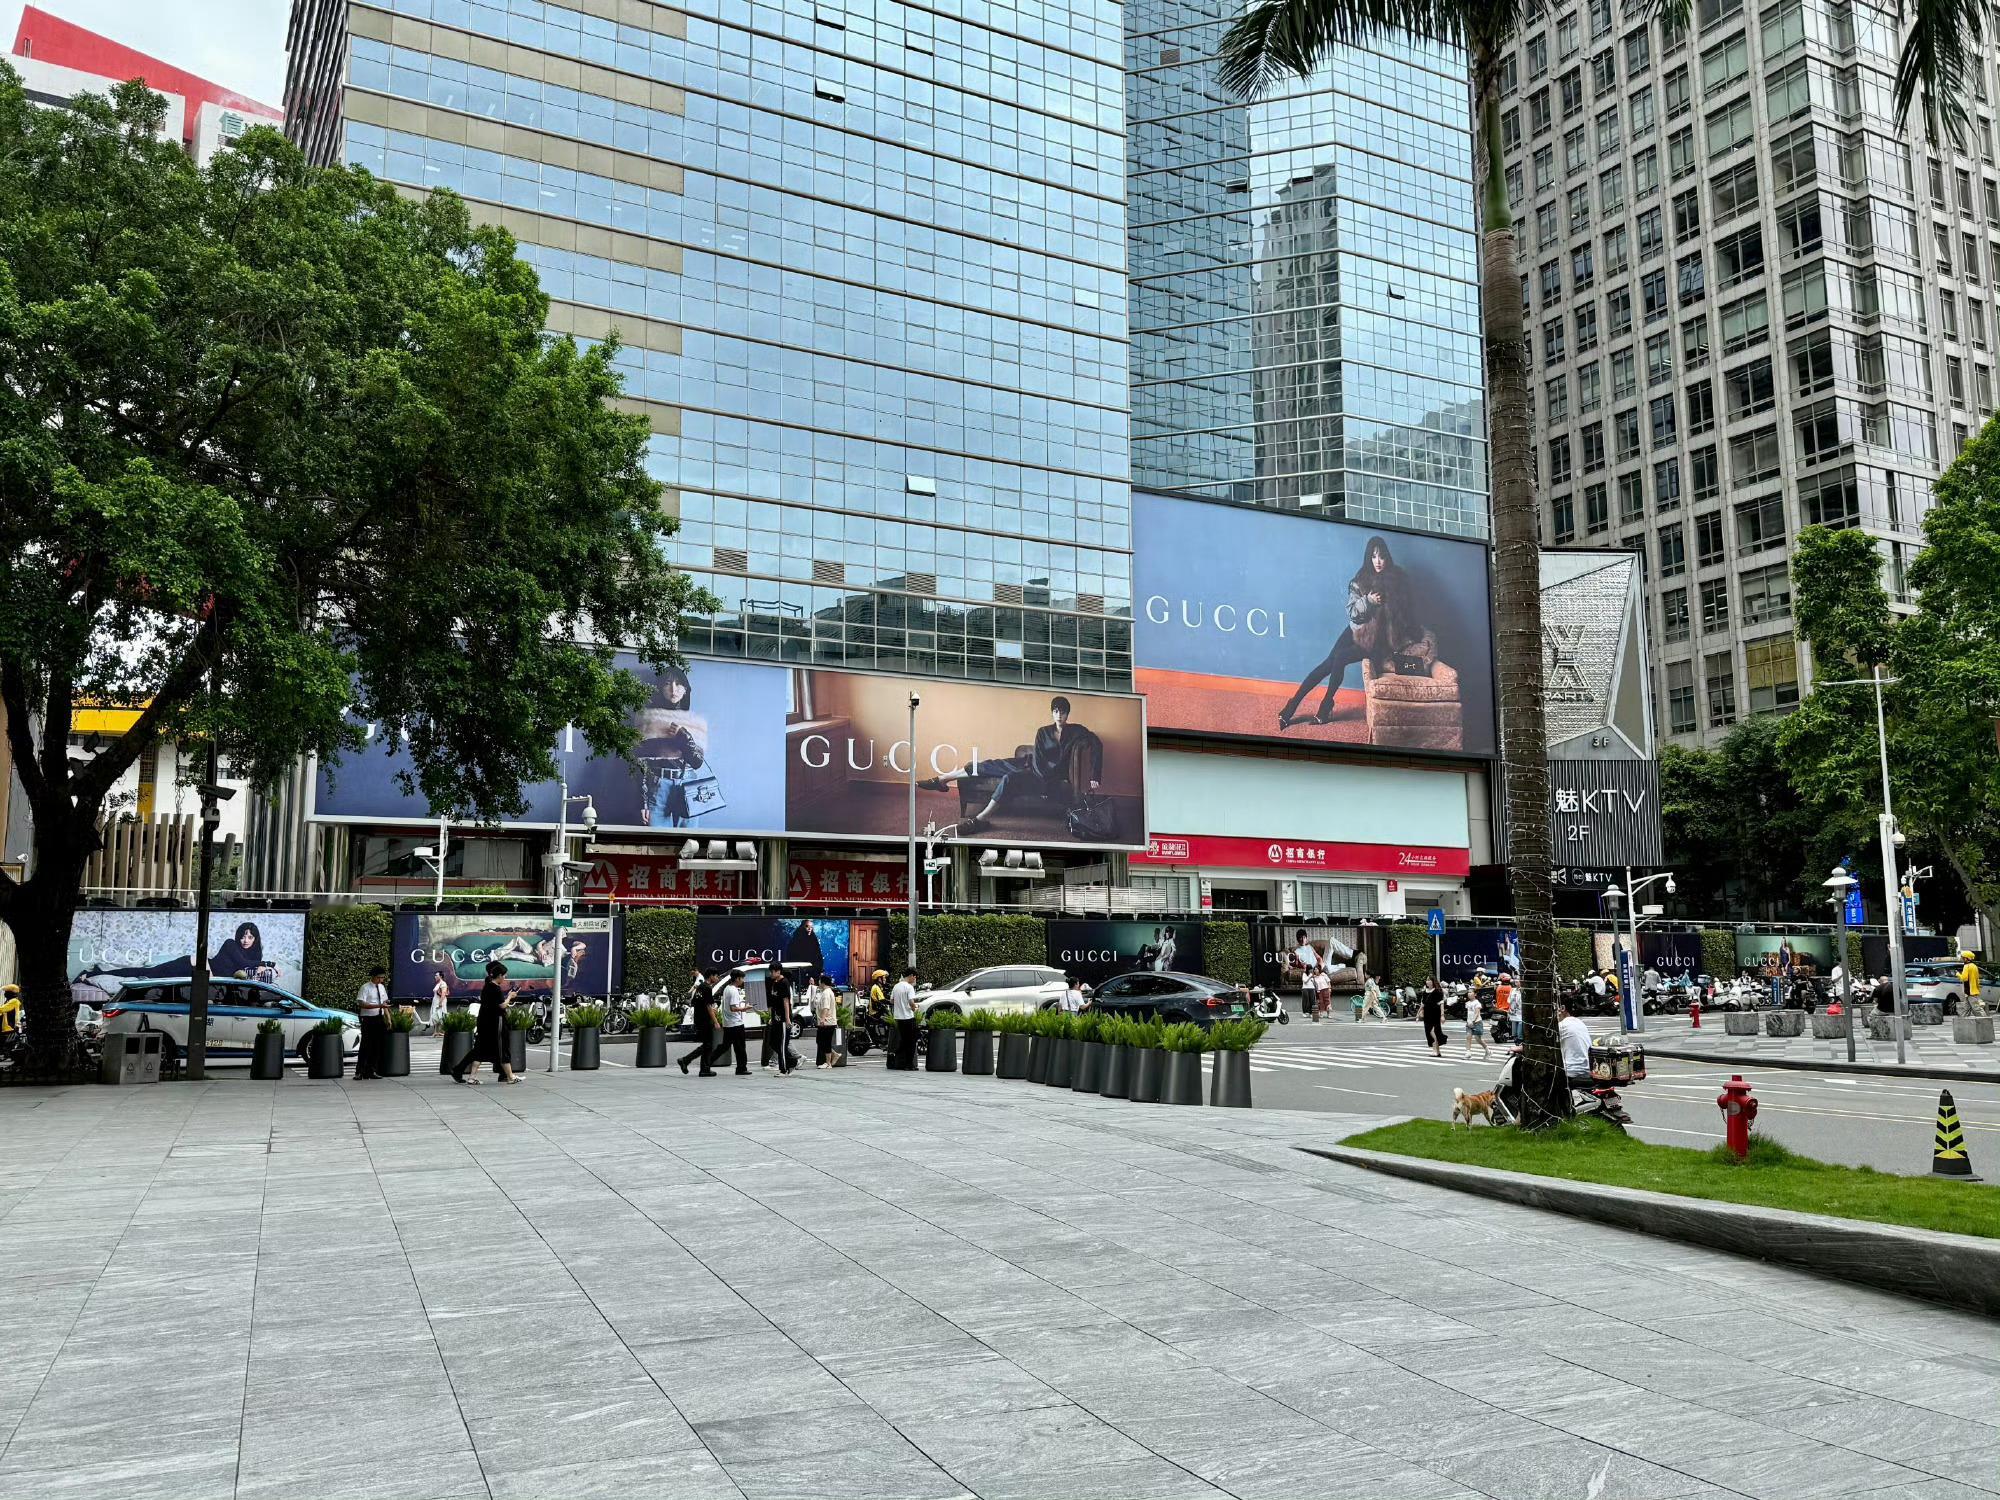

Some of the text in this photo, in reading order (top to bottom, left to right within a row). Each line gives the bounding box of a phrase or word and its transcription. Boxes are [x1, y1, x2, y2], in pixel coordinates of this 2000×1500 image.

[1146, 595, 1287, 638] GUCCI
[800, 735, 980, 776] GUCCI
[1555, 787, 1645, 813] 魅KTV
[1567, 825, 1589, 841] 2F
[67, 948, 153, 963] UCCI
[711, 949, 782, 963] GUCCI
[1061, 950, 1118, 962] GUCCI
[1442, 954, 1488, 965] GUCCI
[1656, 956, 1695, 967] GUCCI
[1744, 956, 1780, 967] GUCCI
